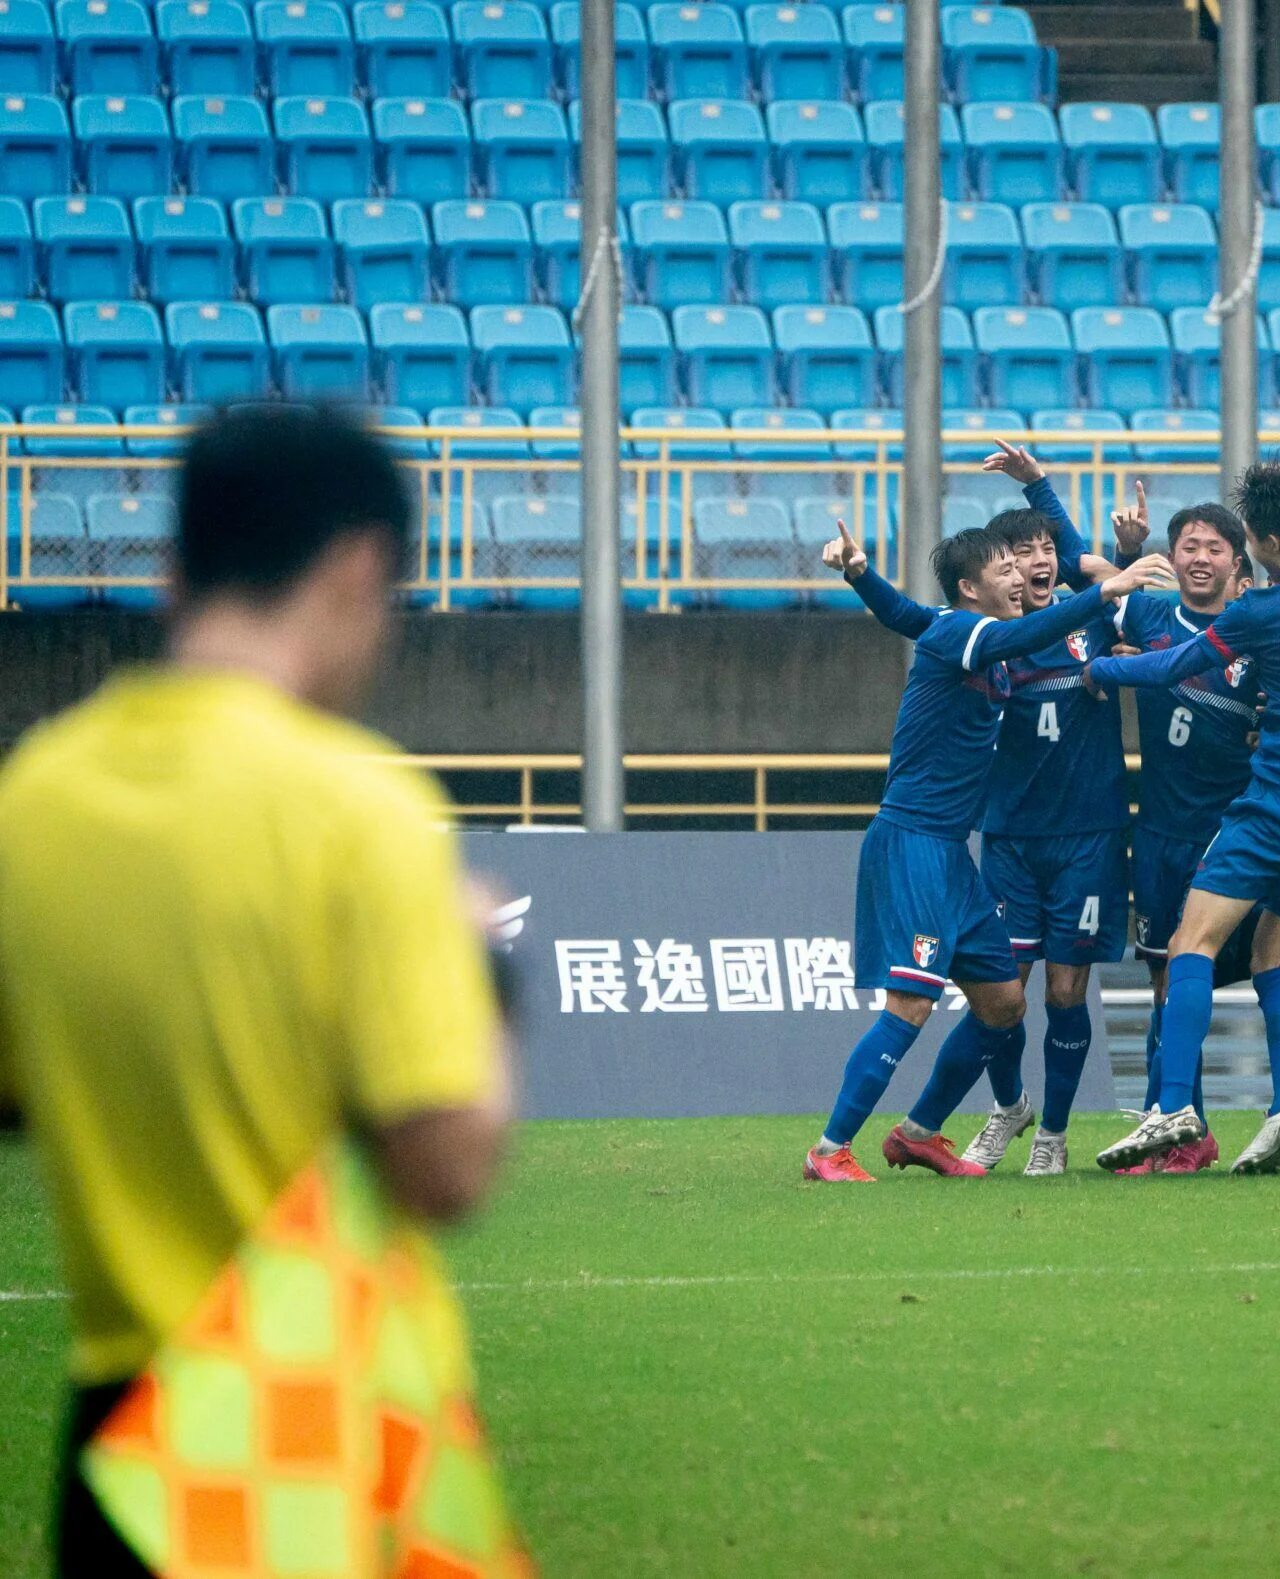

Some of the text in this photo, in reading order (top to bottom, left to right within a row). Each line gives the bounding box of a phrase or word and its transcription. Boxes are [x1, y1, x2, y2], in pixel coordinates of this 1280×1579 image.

[1037, 702, 1061, 742] 4
[1168, 706, 1193, 747] 6
[1078, 896, 1100, 936] 4
[555, 937, 970, 1013] 展逸國際
